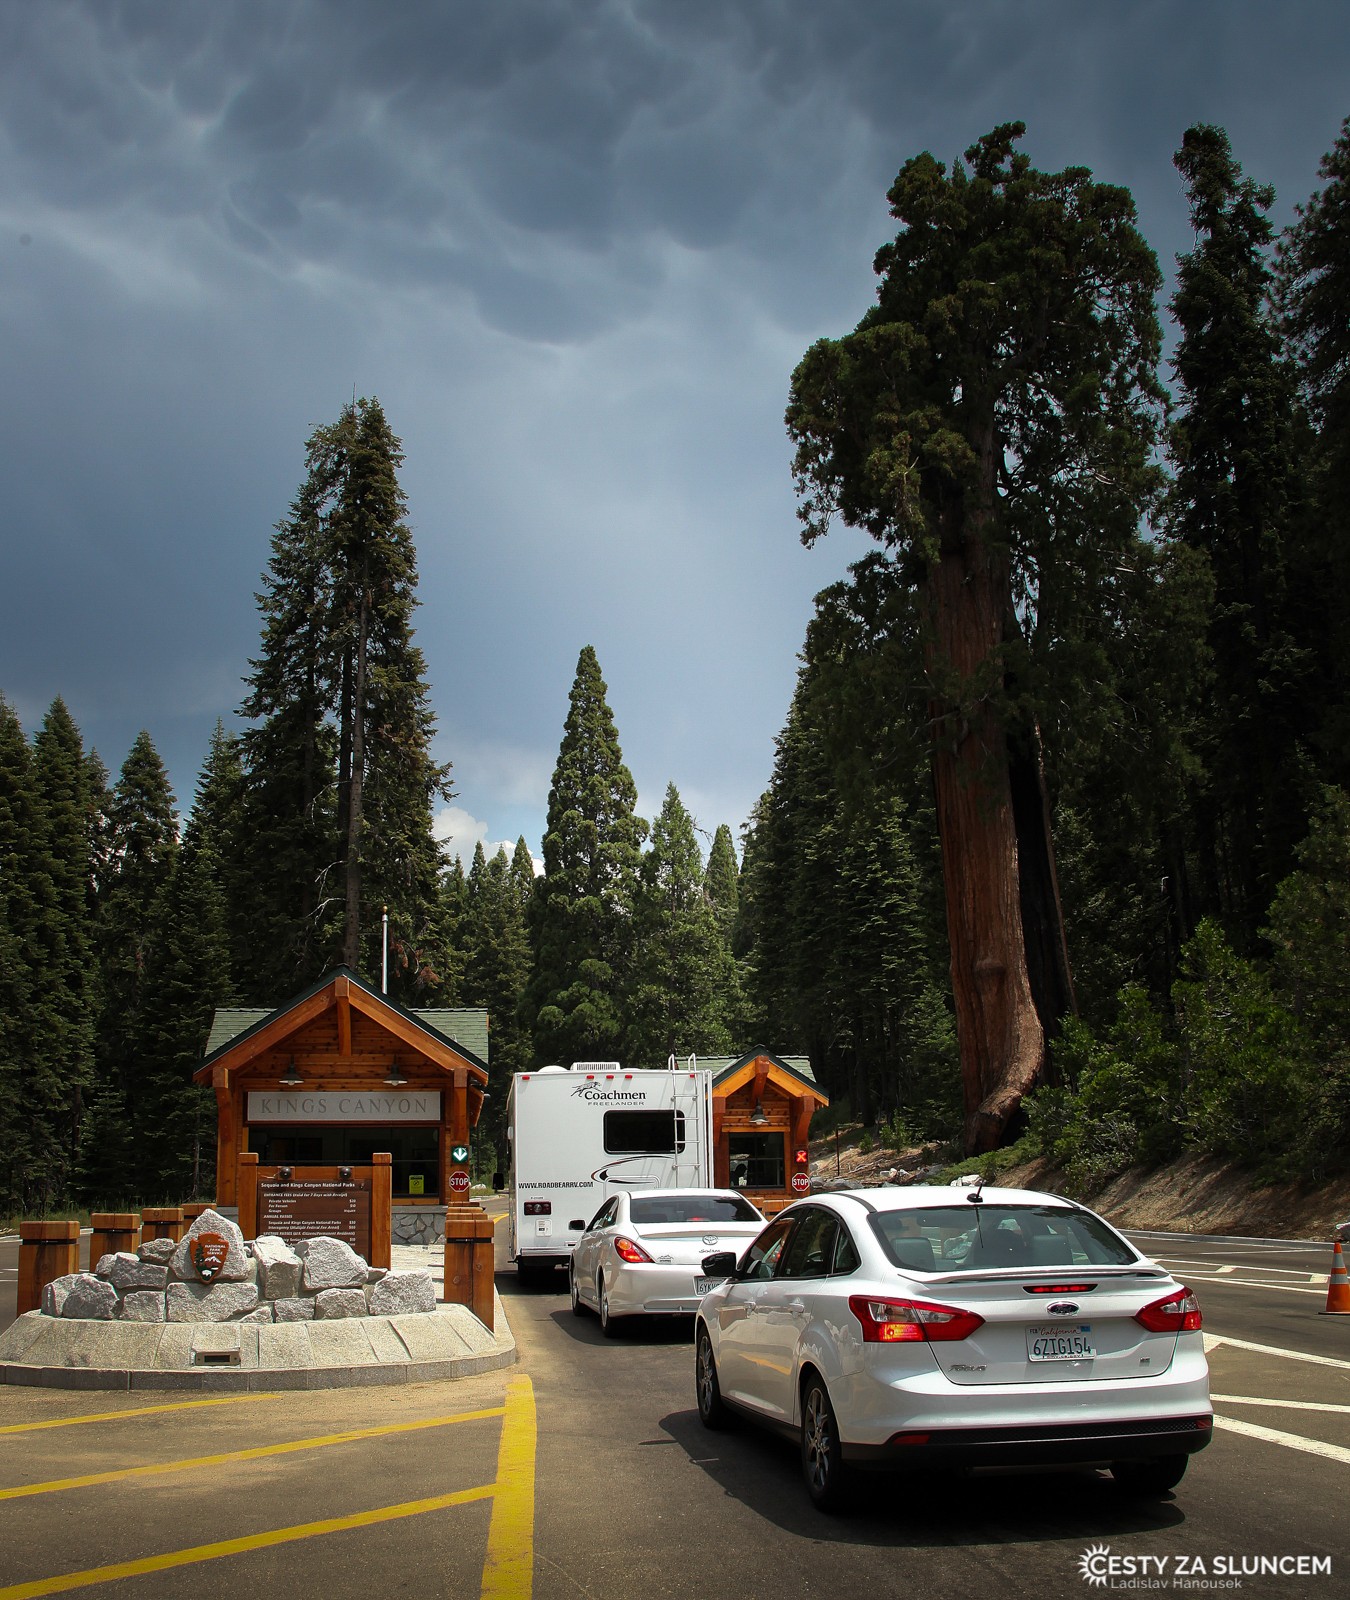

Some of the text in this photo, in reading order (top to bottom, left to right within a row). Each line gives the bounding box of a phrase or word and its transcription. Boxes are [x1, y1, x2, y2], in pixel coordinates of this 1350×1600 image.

[584, 1090, 646, 1100] Coachmen
[261, 1098, 428, 1114] KINGS CANYON
[450, 1177, 469, 1186] STOP
[518, 1181, 594, 1189] WWW.ROADBEARRV.COM
[1040, 1327, 1080, 1337] California
[1033, 1337, 1092, 1356] 6ZIG154
